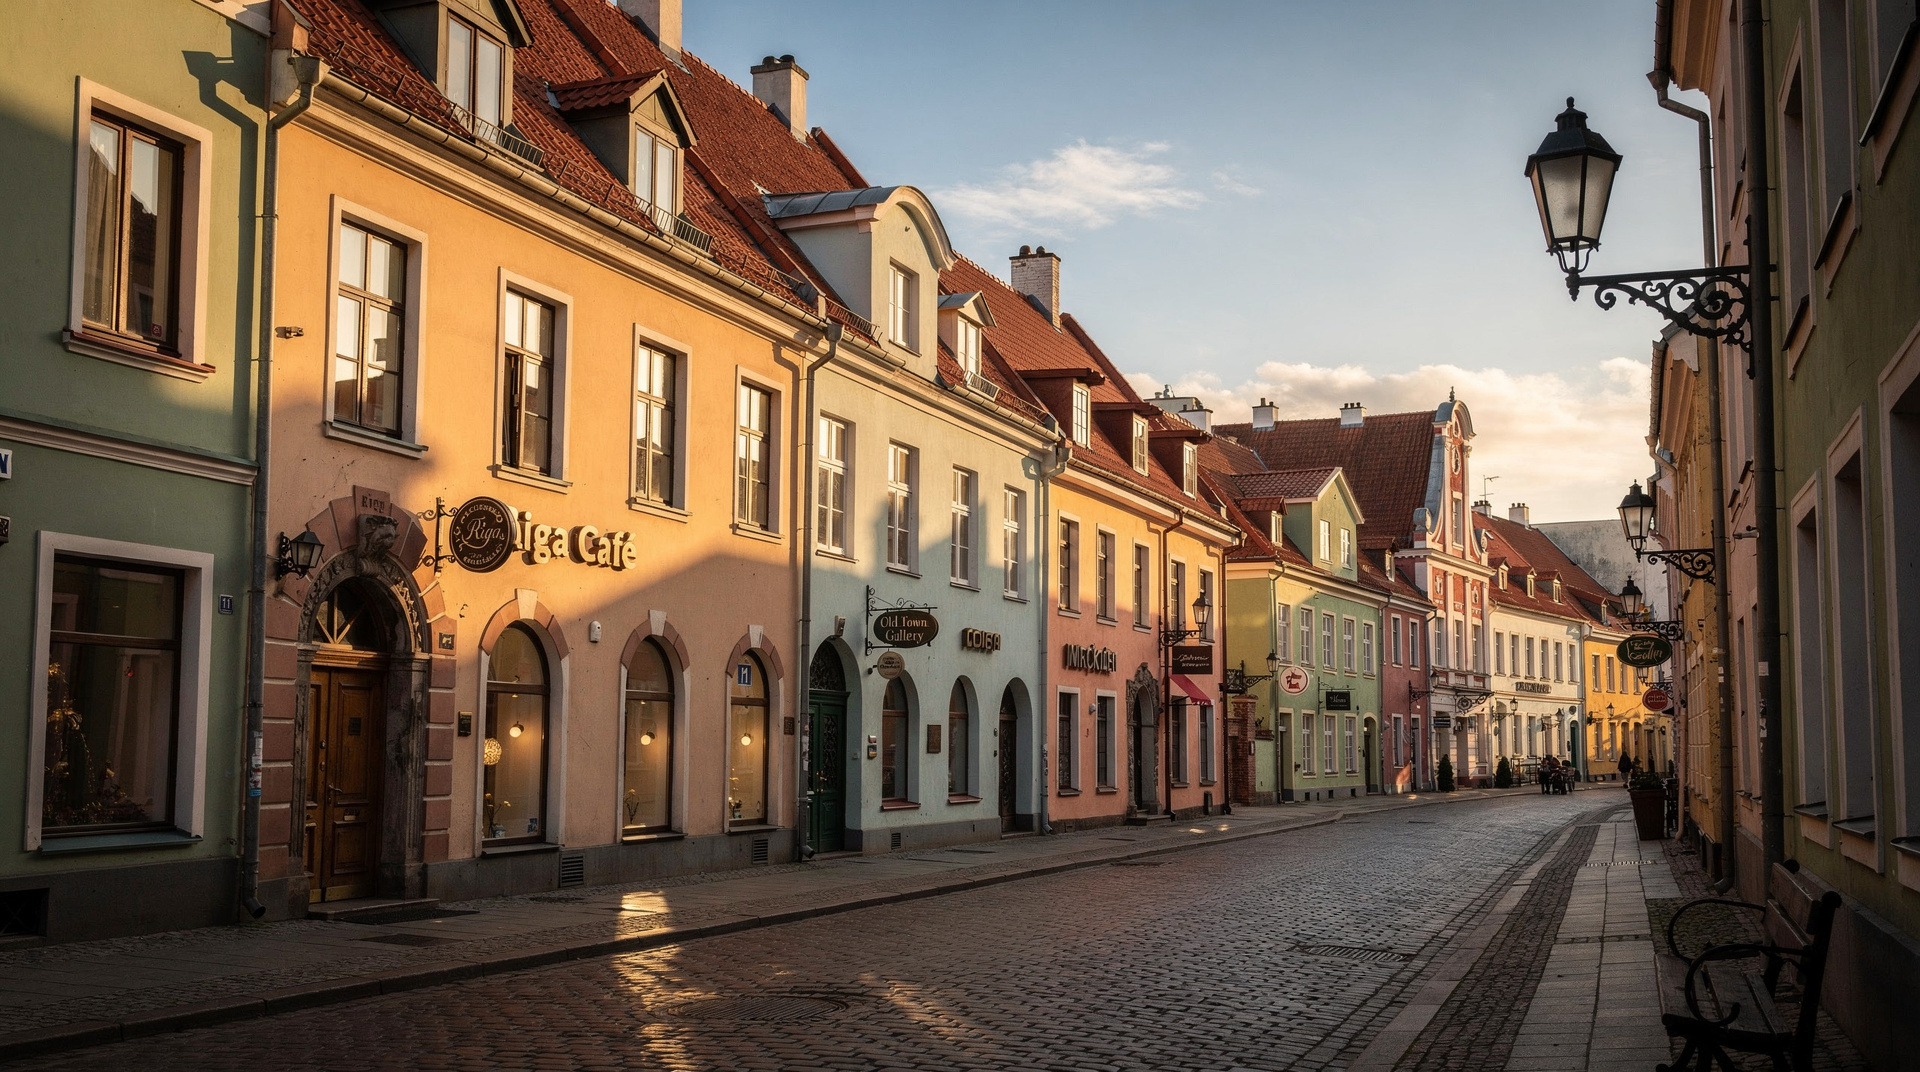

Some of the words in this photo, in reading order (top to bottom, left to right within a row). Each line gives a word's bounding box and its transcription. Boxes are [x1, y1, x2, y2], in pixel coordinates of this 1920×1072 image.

[578, 525, 637, 570] Café
[222, 597, 230, 609] 11
[880, 615, 898, 628] Old
[901, 615, 927, 628] Town
